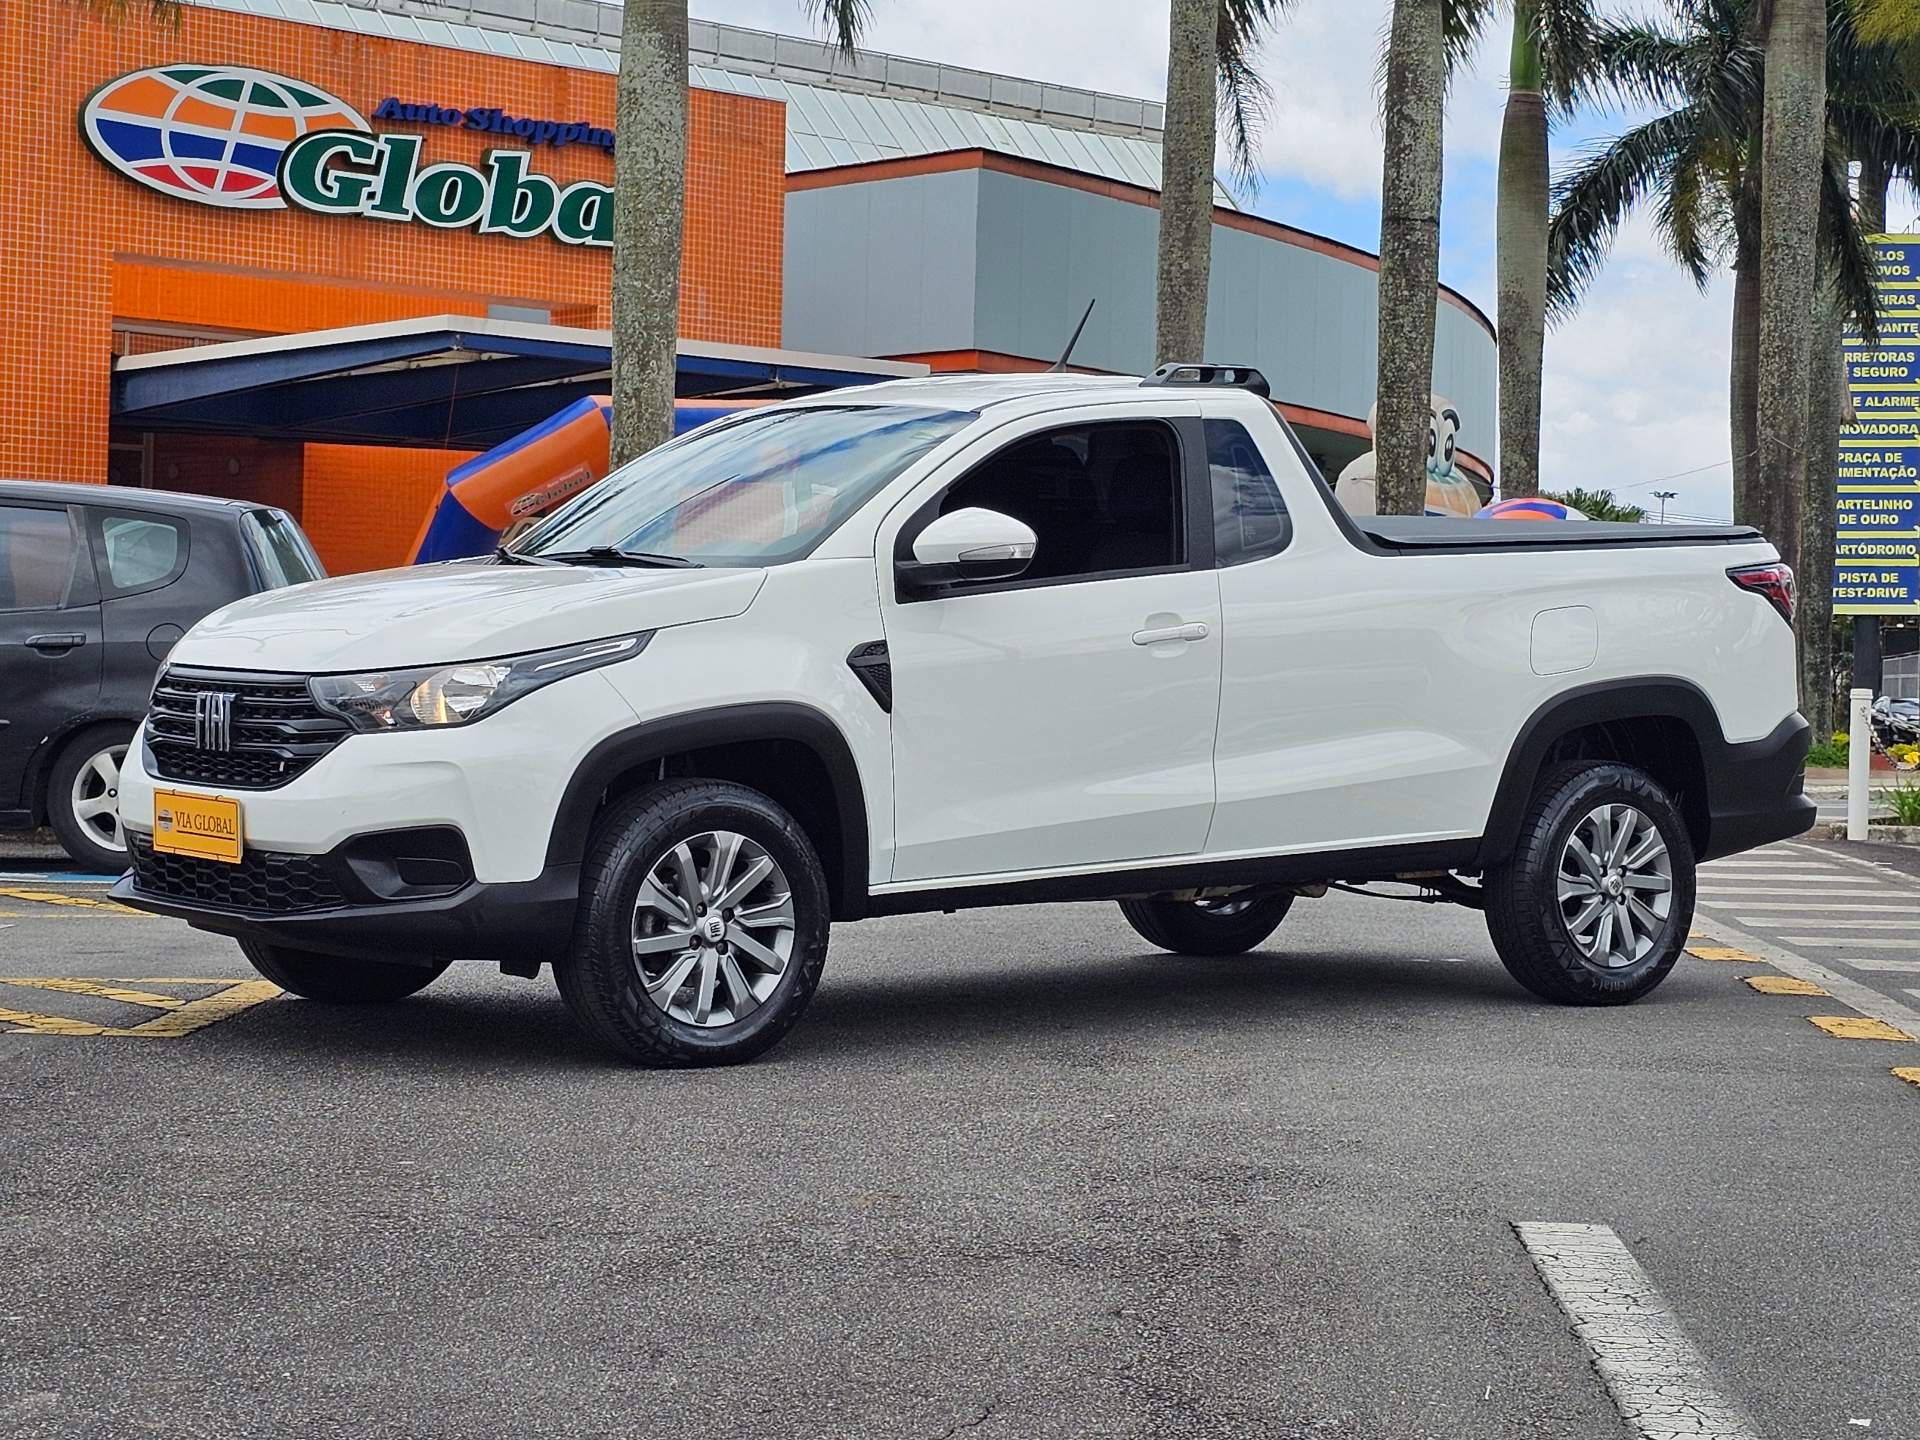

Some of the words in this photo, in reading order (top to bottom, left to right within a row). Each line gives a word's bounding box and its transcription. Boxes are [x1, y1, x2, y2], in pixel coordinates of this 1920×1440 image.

[372, 97, 462, 126] Auto
[463, 107, 615, 155] Shoppin
[1873, 250, 1905, 262] LOS
[1876, 265, 1911, 276] OVOS
[1878, 294, 1916, 306] EIRAS
[1844, 352, 1916, 363] RRETORAS
[1852, 366, 1909, 378] SEGURO
[1852, 396, 1862, 407] E
[1864, 396, 1920, 407] ALARME
[1839, 424, 1919, 435] NOVADORA
[1838, 452, 1882, 466] PRAÇA
[1884, 452, 1903, 463] DE
[1838, 465, 1918, 480] IMENTAÇÃO
[1836, 499, 1913, 510] ARTELINHO
[1839, 514, 1857, 525] DE
[1860, 514, 1899, 525] OURO
[1839, 572, 1878, 583] PISTA
[1881, 572, 1899, 583] DE
[1832, 587, 1908, 598] TEST-DRIVE
[175, 811, 193, 829] VIA
[194, 814, 236, 835] GLOBAL
